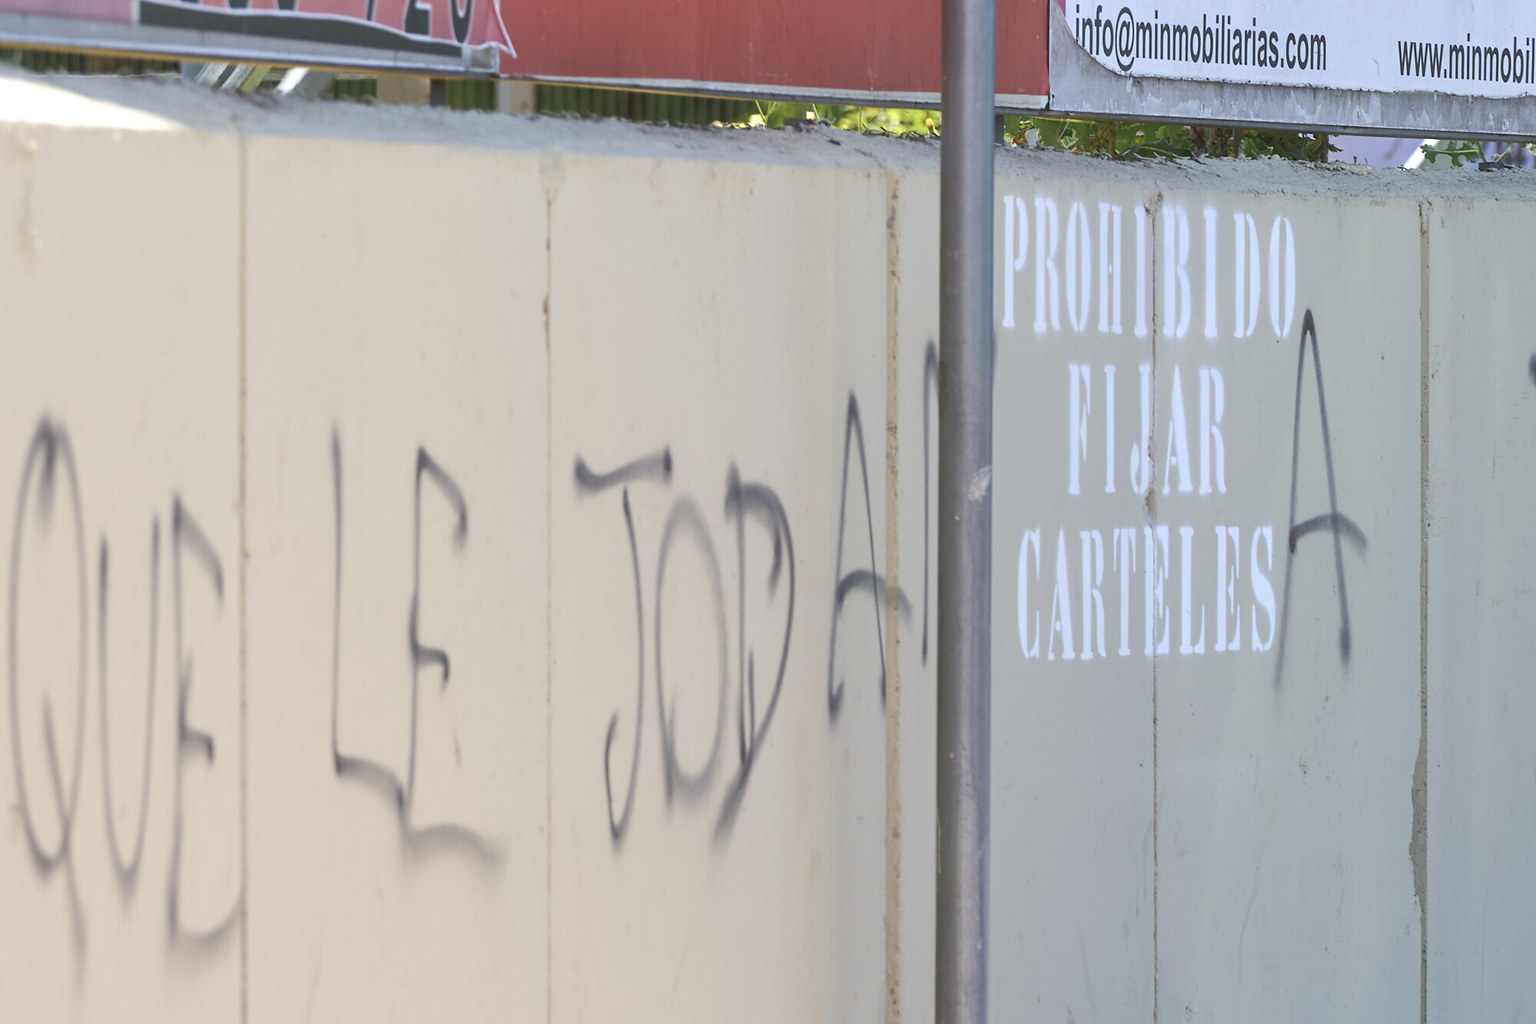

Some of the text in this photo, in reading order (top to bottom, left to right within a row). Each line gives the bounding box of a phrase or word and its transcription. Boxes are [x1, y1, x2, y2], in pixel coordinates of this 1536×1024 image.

[1075, 4, 1327, 71] info@minmobiliarias.com
[1003, 195, 1297, 338] PROHIBIDO
[1067, 363, 1227, 495] FIJAR
[9, 412, 245, 982] QUE
[330, 420, 508, 866] LE
[1272, 307, 1371, 690] A
[1016, 525, 1277, 660] CARTELES
